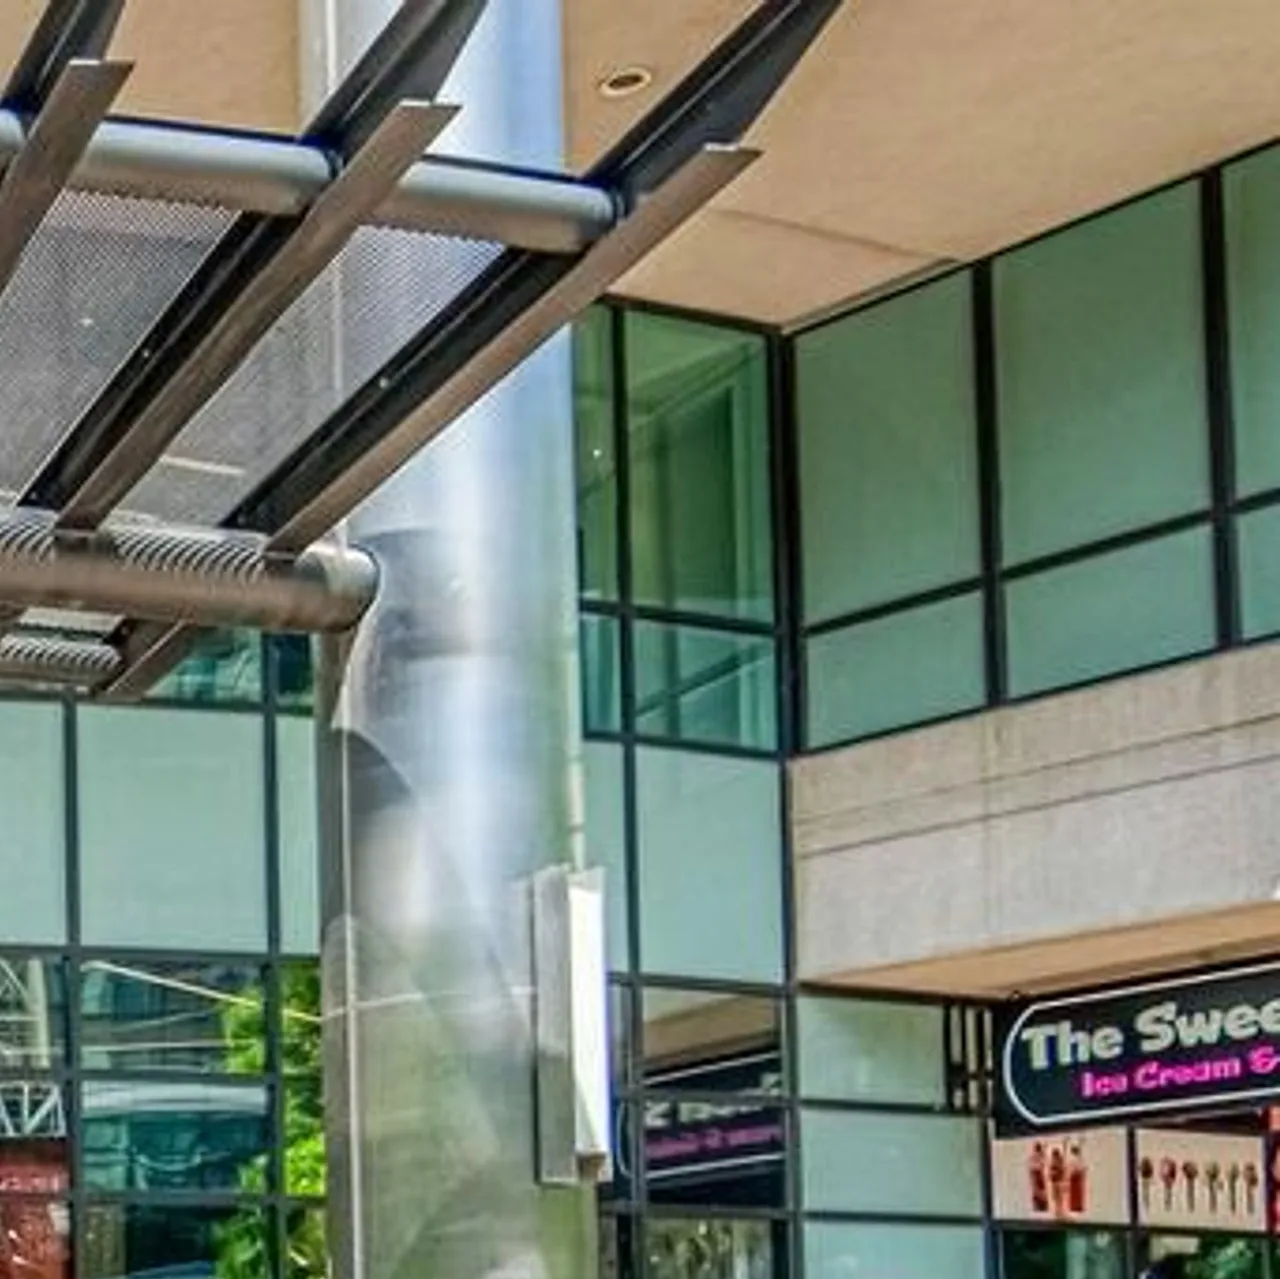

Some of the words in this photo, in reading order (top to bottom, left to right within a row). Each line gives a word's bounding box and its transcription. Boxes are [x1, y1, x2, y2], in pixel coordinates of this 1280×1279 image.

[1021, 1021, 1124, 1070] The
[1081, 1069, 1128, 1098] Ice
[1133, 1056, 1242, 1090] Cream
